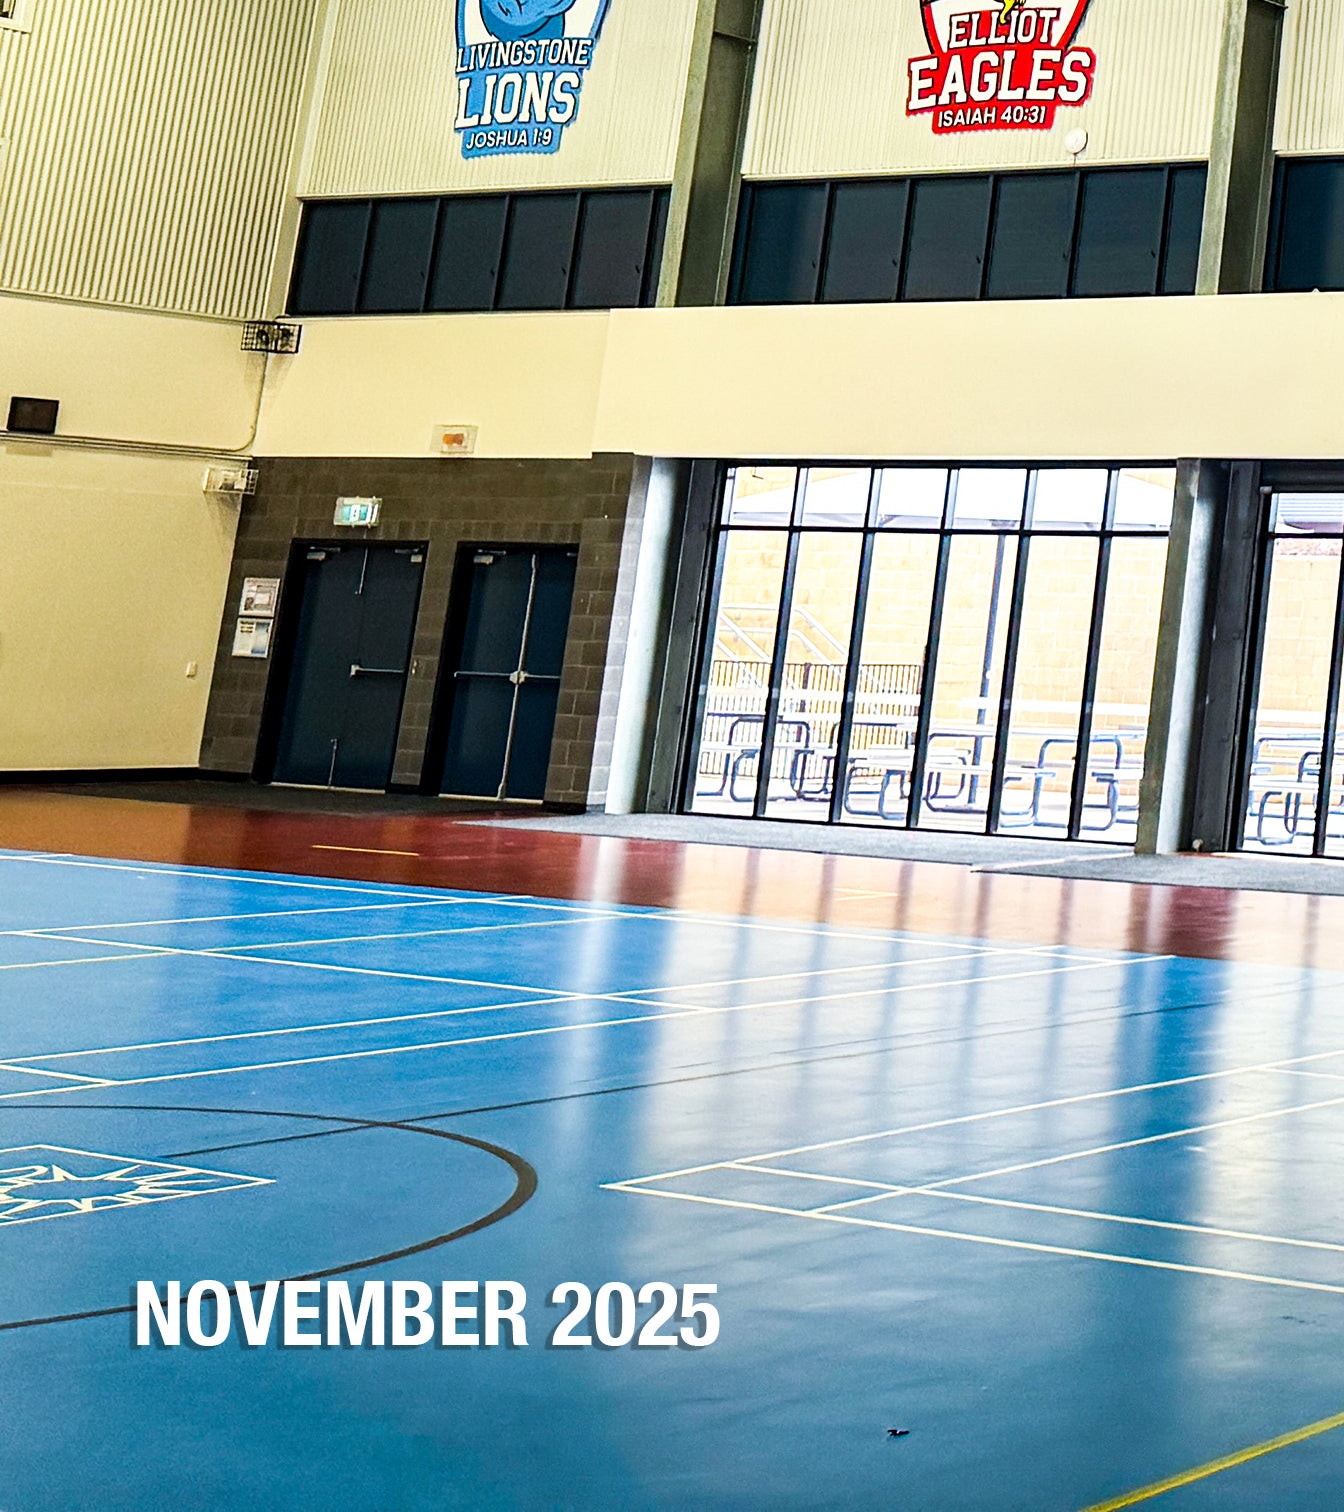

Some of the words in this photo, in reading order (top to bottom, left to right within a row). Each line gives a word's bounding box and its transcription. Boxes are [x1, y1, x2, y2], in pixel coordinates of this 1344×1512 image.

[949, 9, 1058, 48] ELLIOT
[456, 39, 592, 72] LIVINGSTONE
[908, 49, 1091, 111] EAGLES
[455, 71, 580, 129] LIONS
[938, 106, 996, 128] ISAIAH
[1001, 105, 1046, 124] 40:31
[466, 128, 527, 149] JOSHUA
[533, 128, 551, 145] 1:9
